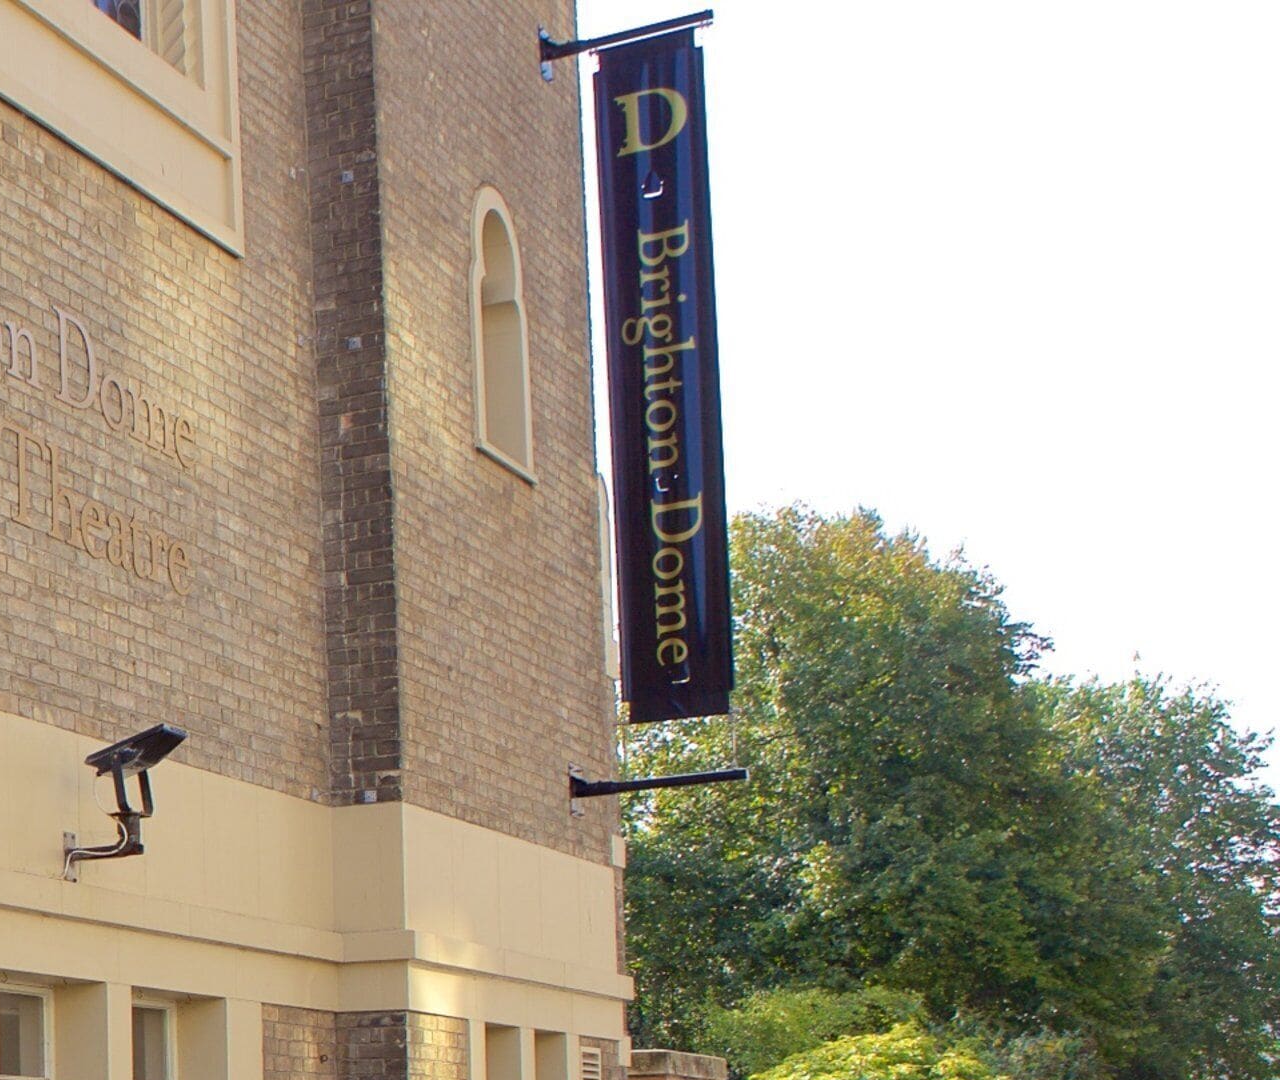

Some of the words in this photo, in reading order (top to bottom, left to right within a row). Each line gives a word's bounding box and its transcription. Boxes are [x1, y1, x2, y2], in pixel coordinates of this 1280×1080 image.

[614, 87, 688, 158] D
[53, 303, 199, 471] Dome
[621, 218, 696, 474] Brighton
[646, 490, 703, 667] Dome
